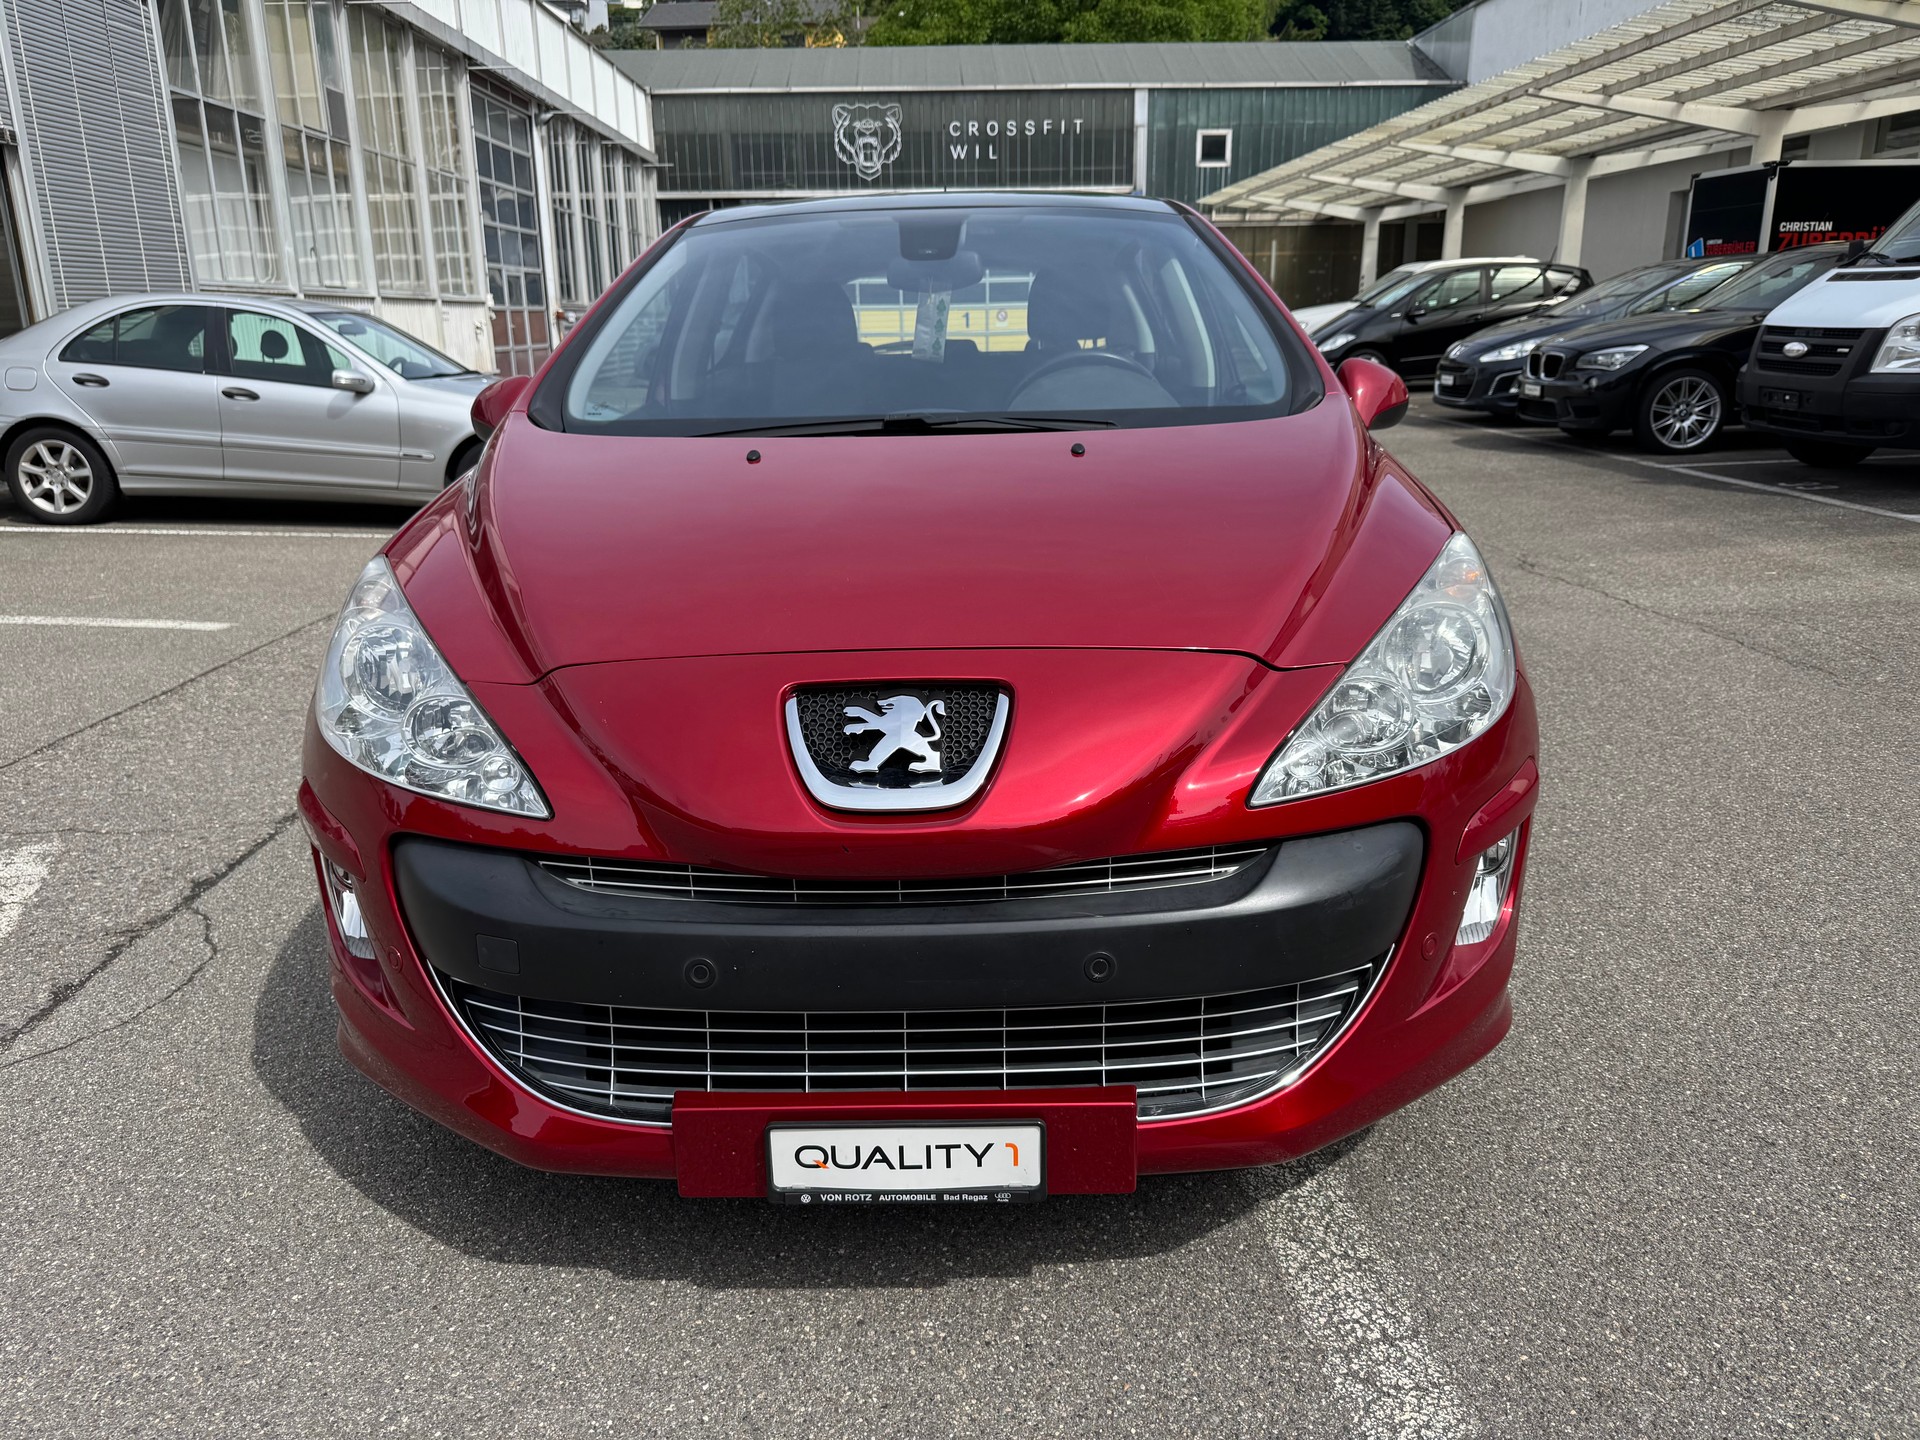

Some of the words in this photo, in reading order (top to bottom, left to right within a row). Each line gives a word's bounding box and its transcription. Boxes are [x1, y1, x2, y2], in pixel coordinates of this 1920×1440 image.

[949, 119, 1084, 136] CROSSFIT
[949, 144, 998, 160] WIL
[1779, 221, 1833, 232] CHRISTIAN
[962, 312, 971, 328] 1
[794, 1143, 995, 1170] QUALITY
[820, 1193, 842, 1202] VON
[844, 1193, 873, 1202] ROTZ
[878, 1193, 937, 1202] AUTOMOBILE
[943, 1193, 960, 1201] Bad
[962, 1193, 989, 1203] Ragaz
